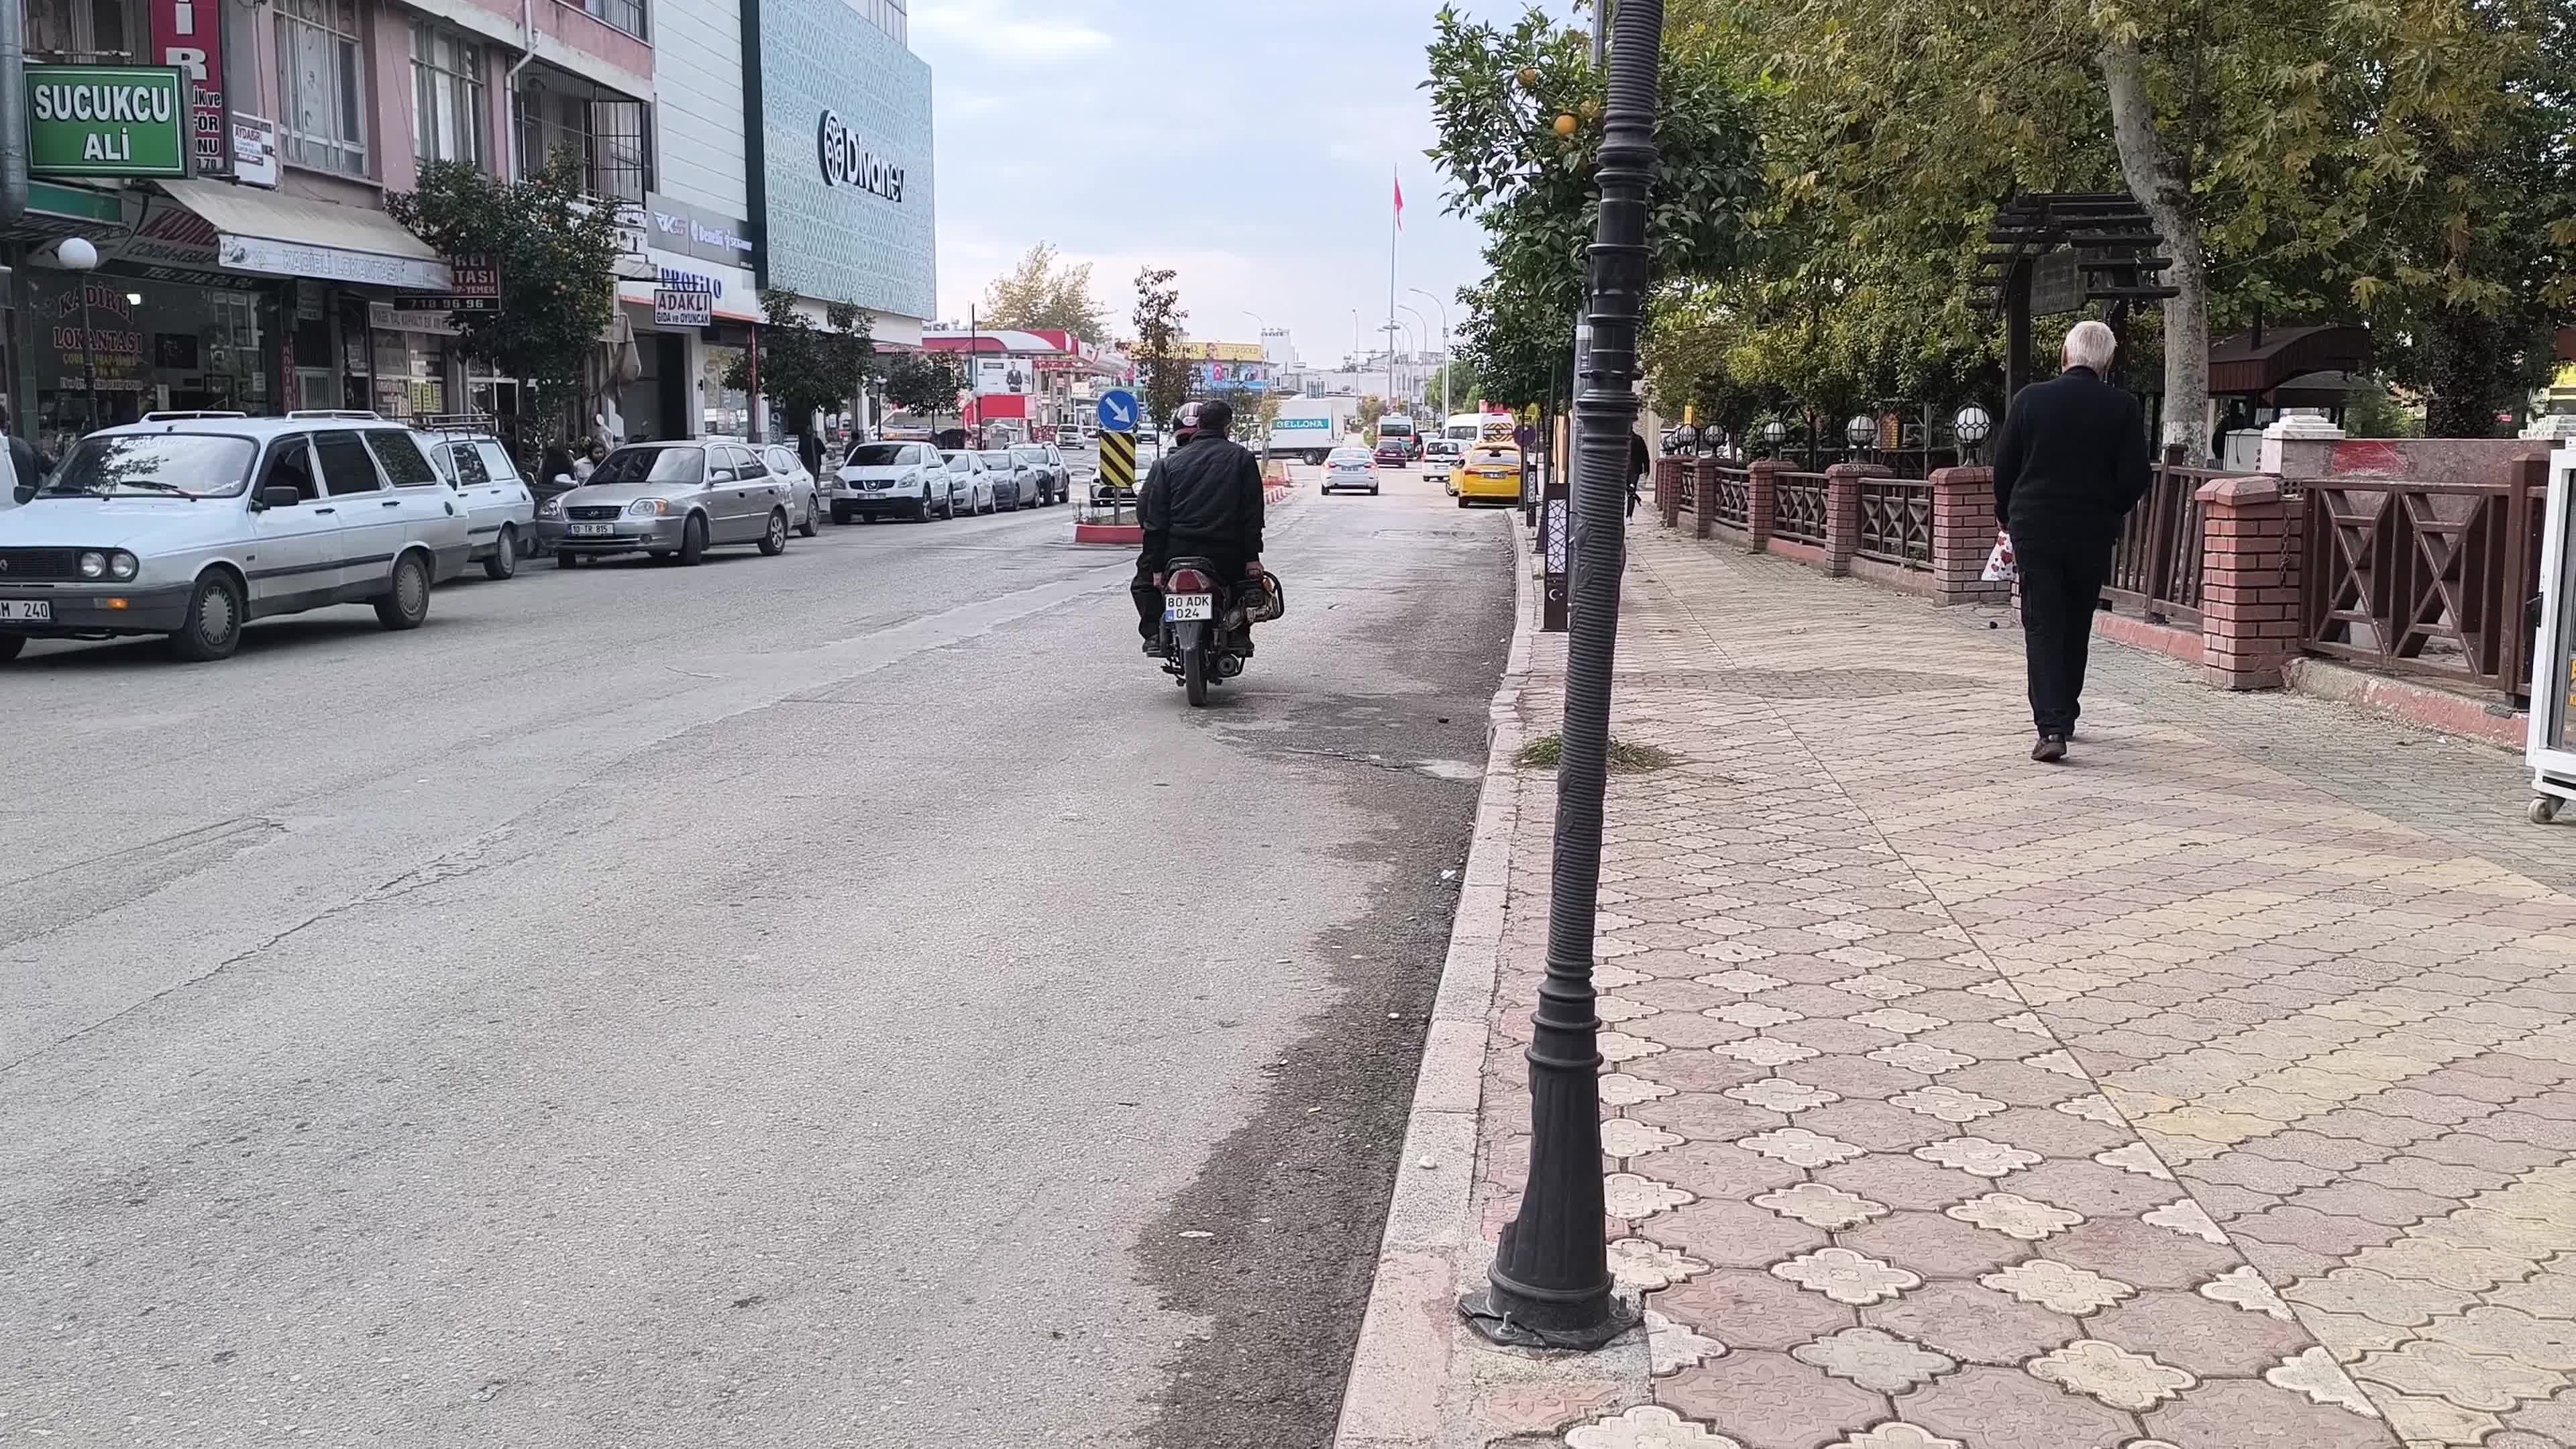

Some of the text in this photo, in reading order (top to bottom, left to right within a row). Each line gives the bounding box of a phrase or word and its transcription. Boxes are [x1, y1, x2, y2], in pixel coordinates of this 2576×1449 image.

[35, 85, 171, 123] SUCUKCU
[193, 86, 221, 107] İK ve
[83, 127, 131, 161] ALİ
[195, 138, 220, 155] NU
[466, 299, 484, 309] 96
[657, 293, 708, 311] ADAKLI
[656, 311, 709, 324] GIDA ve OYUNCAK
[1168, 596, 1210, 607] 80 ADK
[0, 602, 48, 618] M 240
[1176, 608, 1199, 619] 024
